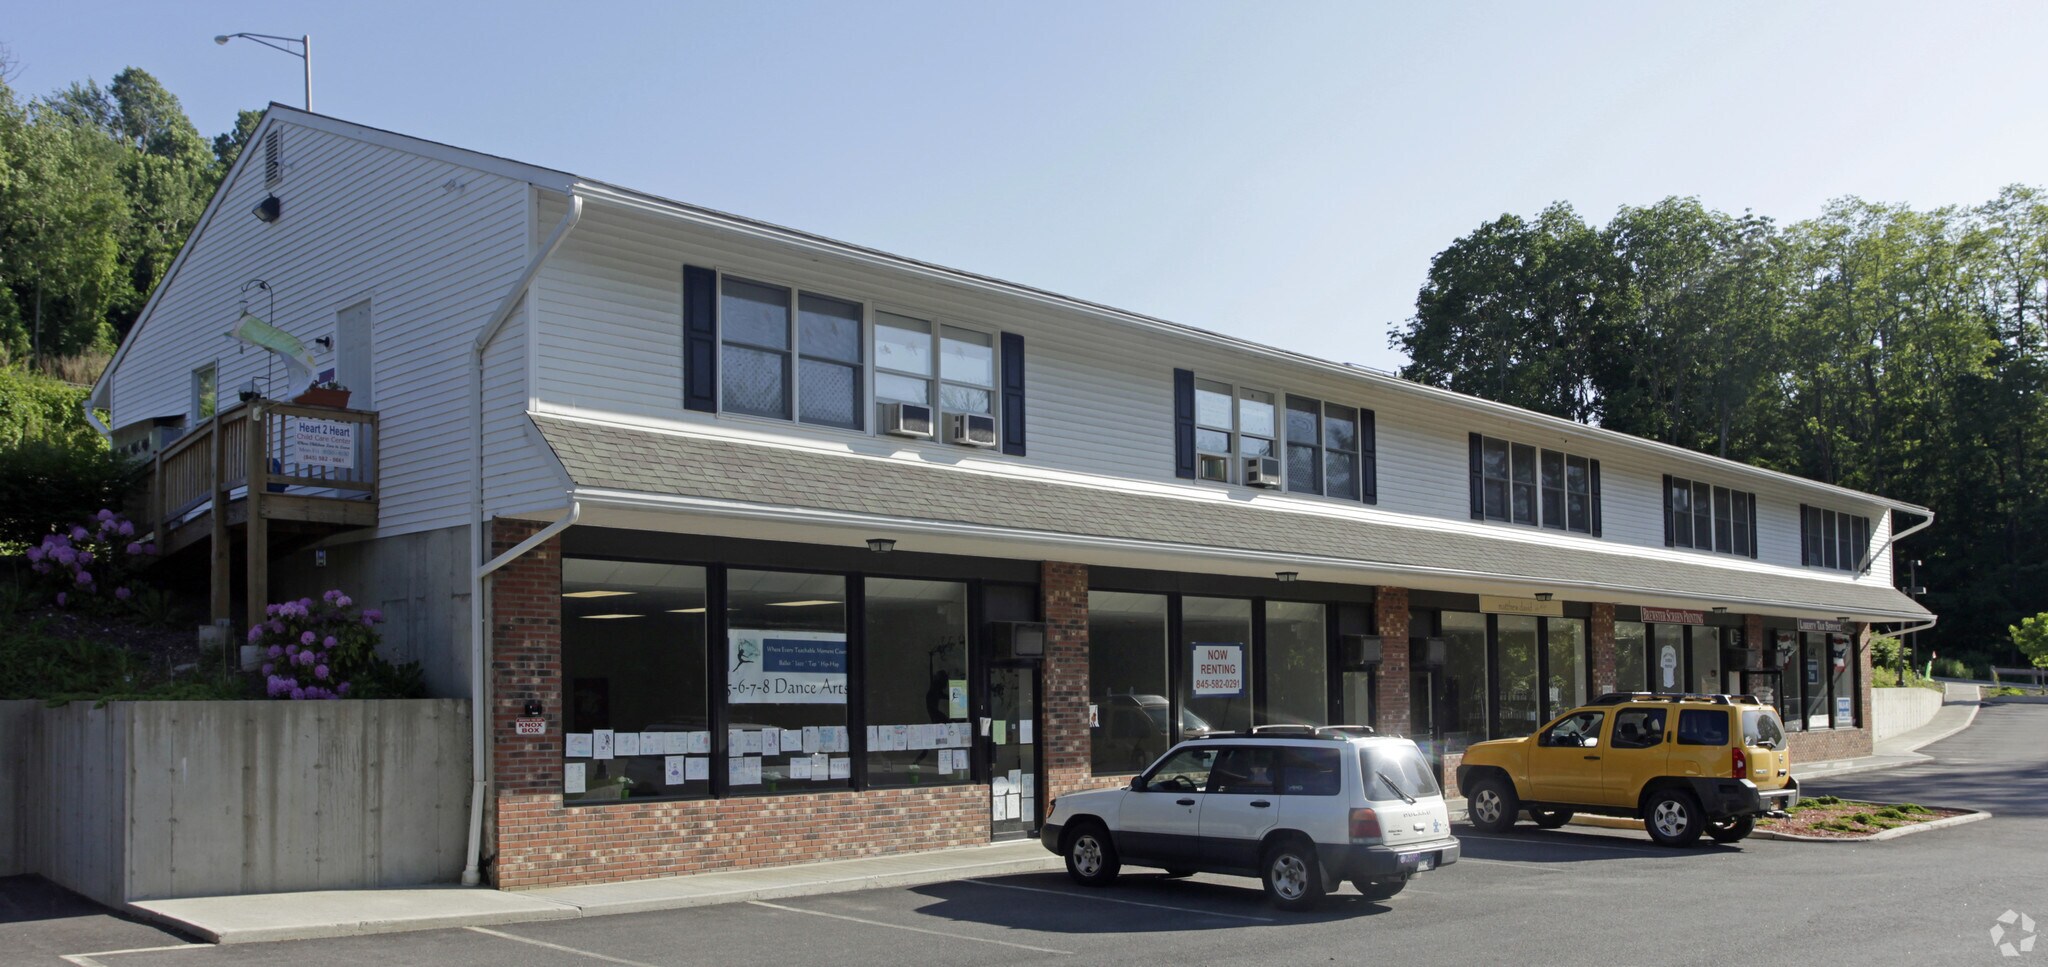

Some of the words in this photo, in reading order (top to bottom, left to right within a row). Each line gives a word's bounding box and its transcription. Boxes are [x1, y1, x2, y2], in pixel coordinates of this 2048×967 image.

[299, 422, 321, 434] Heart
[323, 424, 328, 435] 2
[330, 425, 350, 437] Heart
[331, 437, 351, 445] Center
[1642, 607, 1666, 621] BREWSTER
[1666, 609, 1683, 623] SCREEN
[1683, 610, 1704, 624] PRINTING
[1825, 621, 1842, 632] SERVICE
[1207, 649, 1228, 660] NOW
[1200, 664, 1236, 675] RENTING
[727, 679, 770, 696] 5-6-7-8
[775, 678, 816, 694] Dance
[819, 678, 848, 694] Arts
[1195, 679, 1240, 689] 845-582-0291
